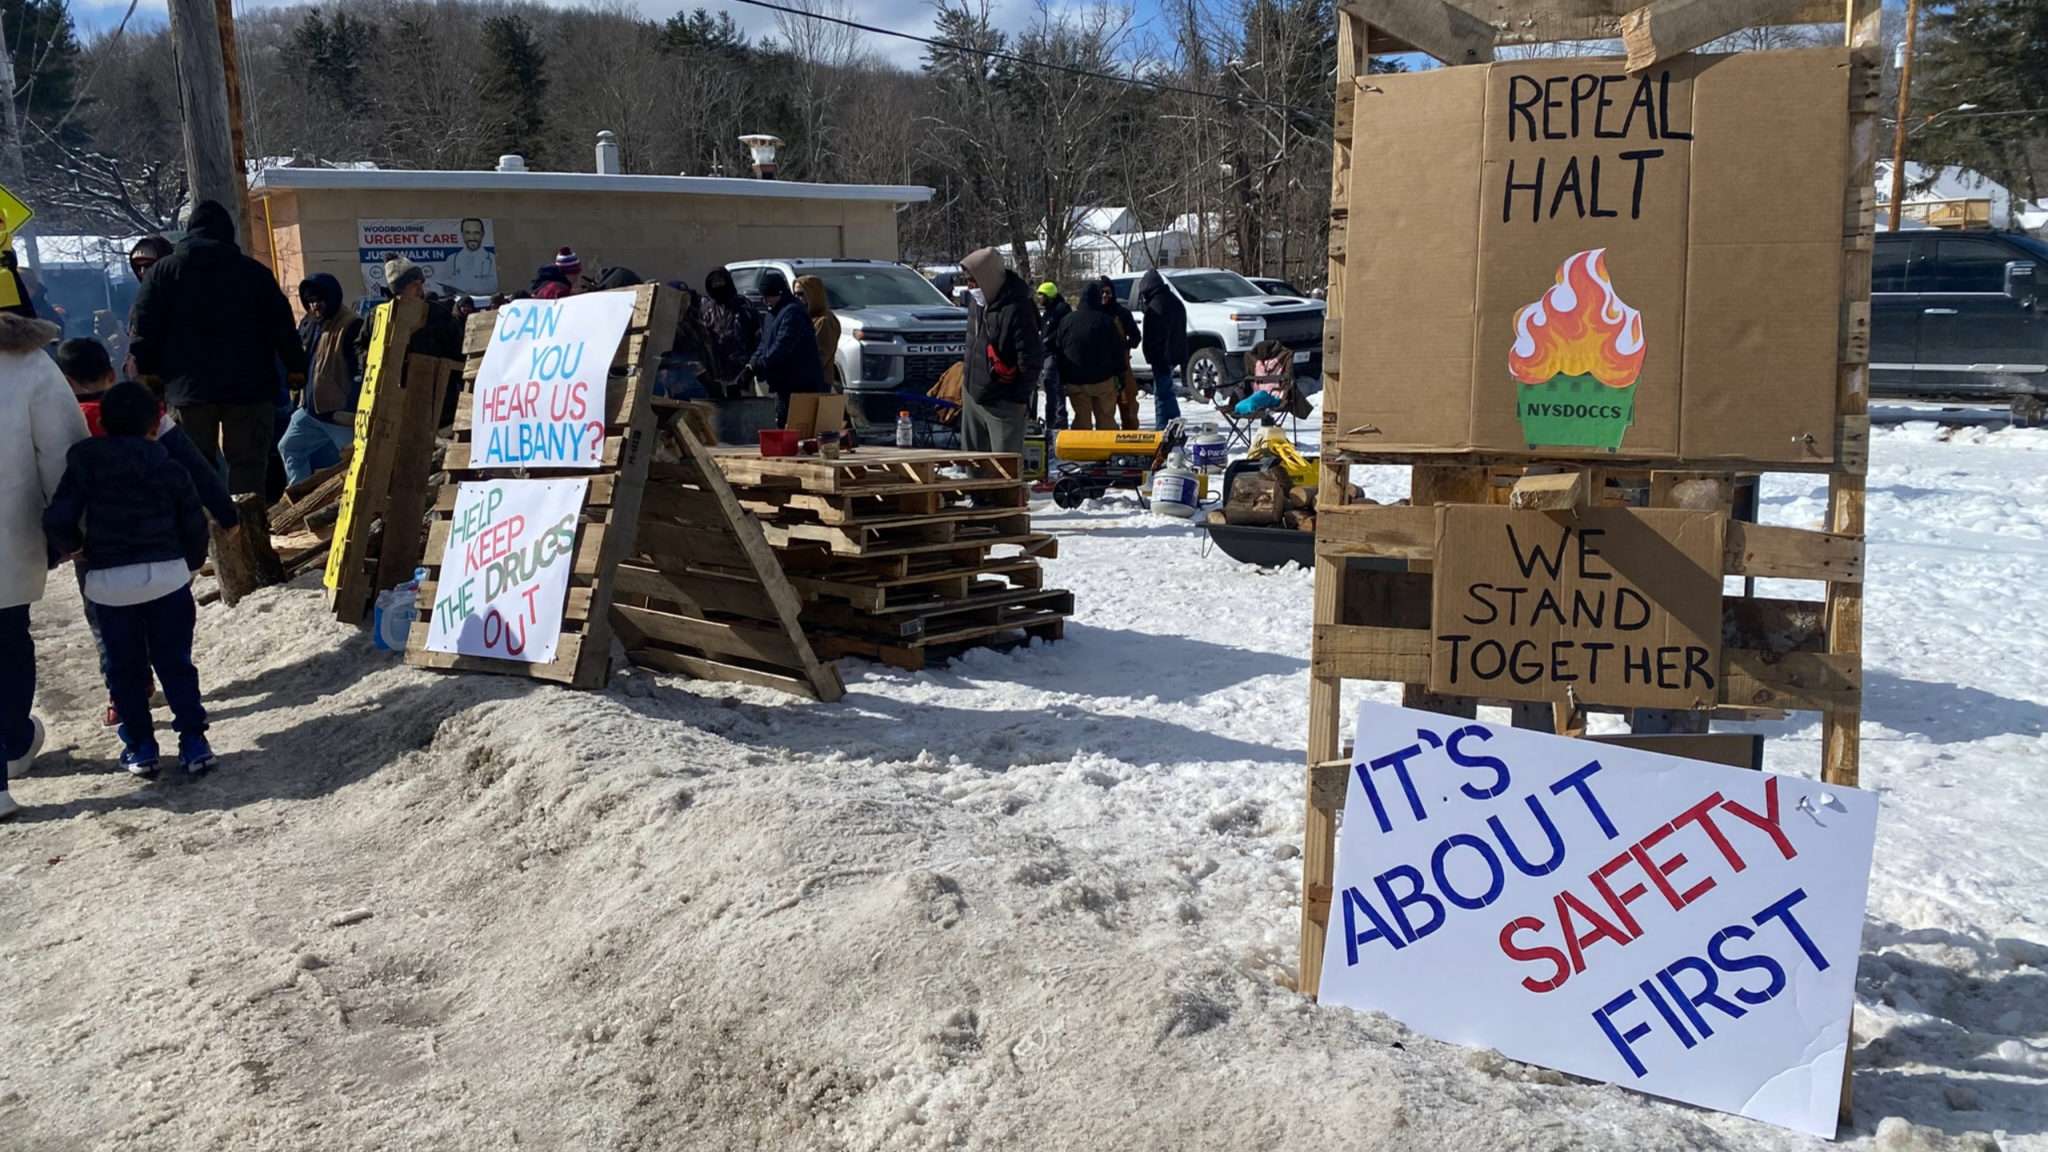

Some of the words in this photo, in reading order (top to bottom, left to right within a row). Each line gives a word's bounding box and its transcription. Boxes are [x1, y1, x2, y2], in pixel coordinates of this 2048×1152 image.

[1508, 70, 1695, 142] REPEAL
[1503, 149, 1665, 223] HALT
[363, 225, 425, 233] WOODBOURNE
[364, 233, 418, 245] URGENT
[423, 233, 459, 244] CARE
[364, 250, 390, 260] JUS
[432, 249, 445, 259] IN
[500, 303, 564, 342] CAN
[906, 344, 967, 353] CHEVR
[528, 342, 585, 381] YOU
[482, 381, 541, 424] HEAR
[551, 381, 588, 422] US
[1527, 403, 1622, 419] NYSDOCCS
[485, 420, 605, 464] ALBANY?
[1115, 433, 1155, 441] MASTER
[450, 487, 504, 549] HELP
[464, 514, 526, 577] KEEP
[436, 577, 475, 635] THE
[485, 513, 576, 604] DRUGS
[1506, 524, 1613, 581] WE
[483, 583, 541, 656] OUT
[1463, 583, 1651, 631] STAND
[1437, 635, 1715, 690] TOGETHER
[1354, 724, 1512, 833] IT'S
[1341, 760, 1619, 966] ABOUT
[1499, 775, 1798, 993] SAFETY
[1591, 887, 1831, 1078] FIRST
